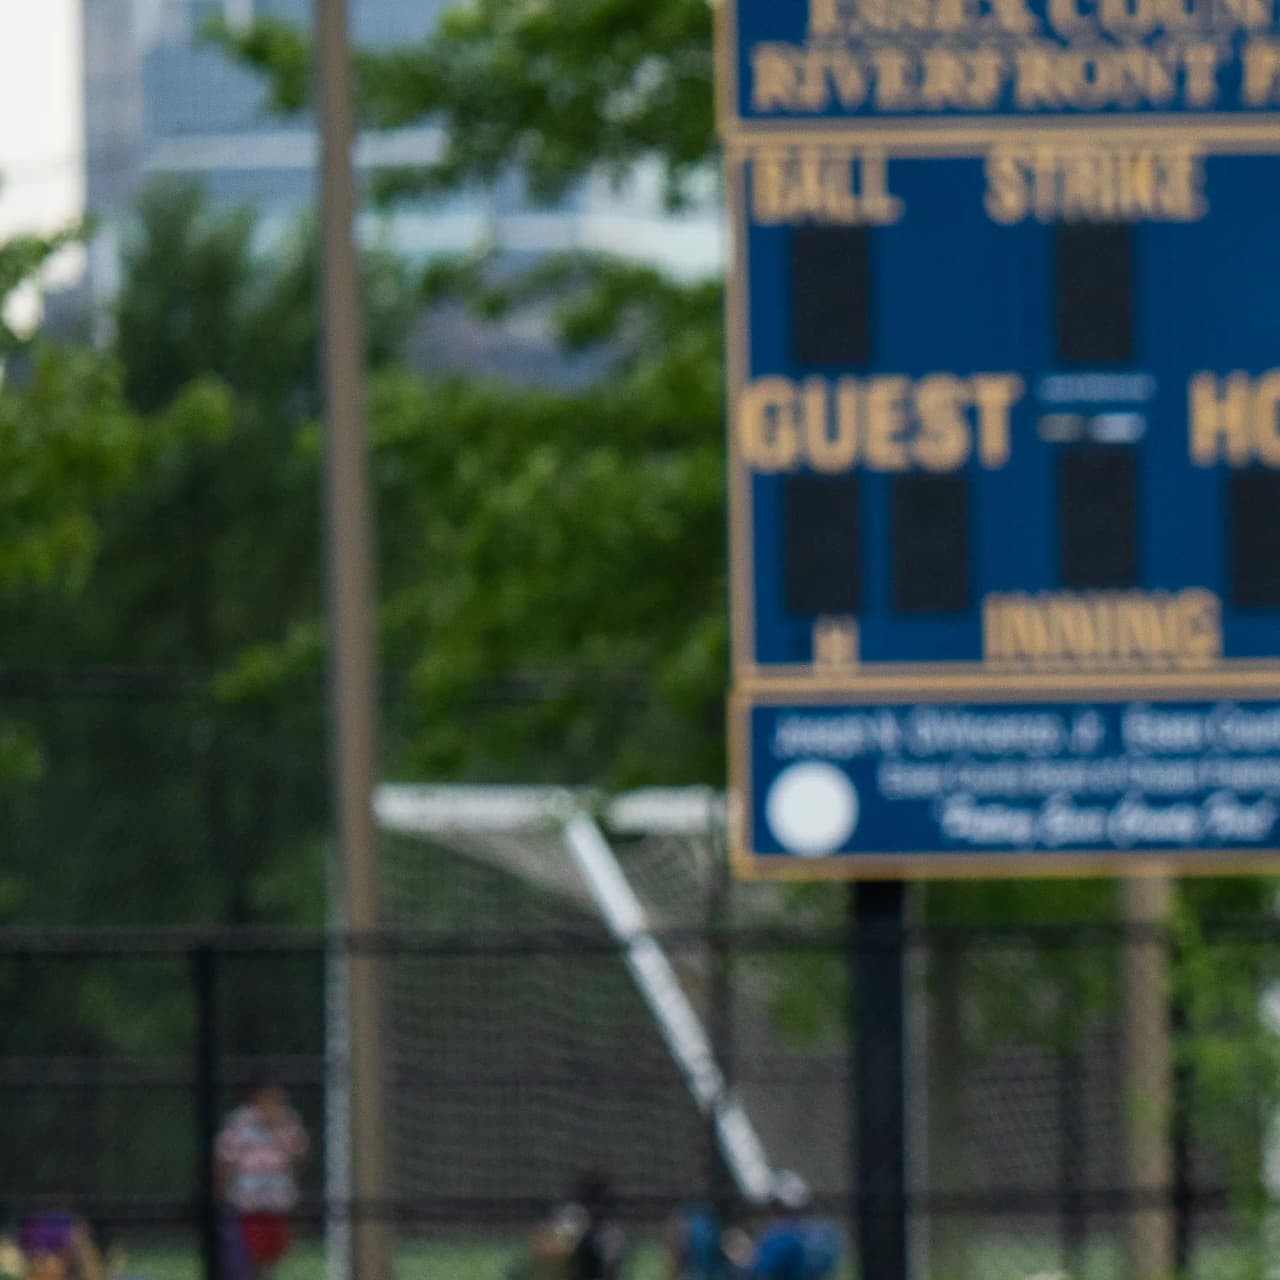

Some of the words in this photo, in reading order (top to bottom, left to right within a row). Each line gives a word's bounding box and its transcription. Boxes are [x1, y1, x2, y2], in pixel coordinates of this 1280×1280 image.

[752, 43, 1226, 112] RIVERFRONT
[750, 146, 902, 224] BALL
[984, 146, 1207, 224] STRIKE
[738, 373, 1023, 472] GUEST
[983, 587, 1222, 670] INNING
